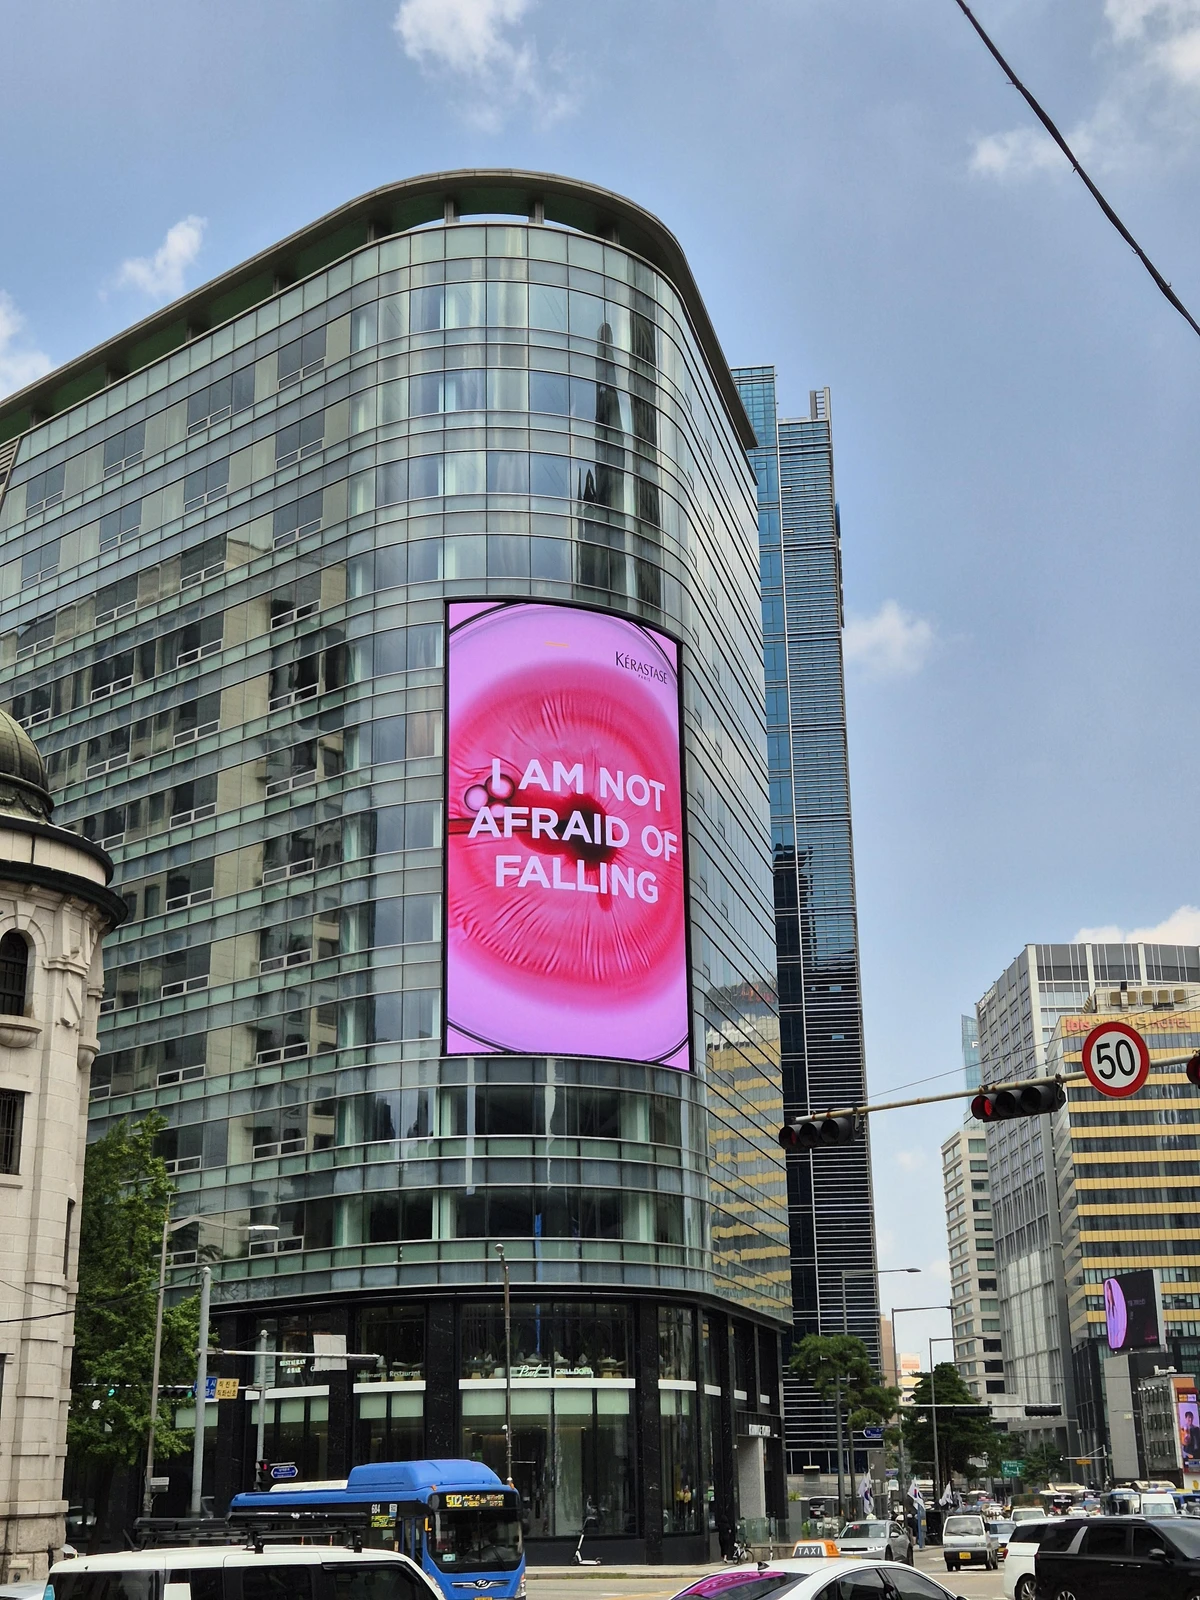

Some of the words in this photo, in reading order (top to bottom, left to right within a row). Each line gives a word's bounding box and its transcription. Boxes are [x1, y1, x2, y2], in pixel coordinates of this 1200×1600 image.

[615, 651, 668, 685] KÉRASTASE
[492, 758, 501, 789] I
[518, 759, 584, 795] AM
[600, 766, 666, 812] NOT
[468, 806, 630, 848] AFRAID
[641, 825, 678, 862] OF
[495, 855, 659, 904] FALLING
[1065, 1018, 1091, 1032] ibis
[1150, 1017, 1190, 1030] HOTEL
[1096, 1039, 1136, 1080] 50
[798, 1547, 820, 1555] TAXI
